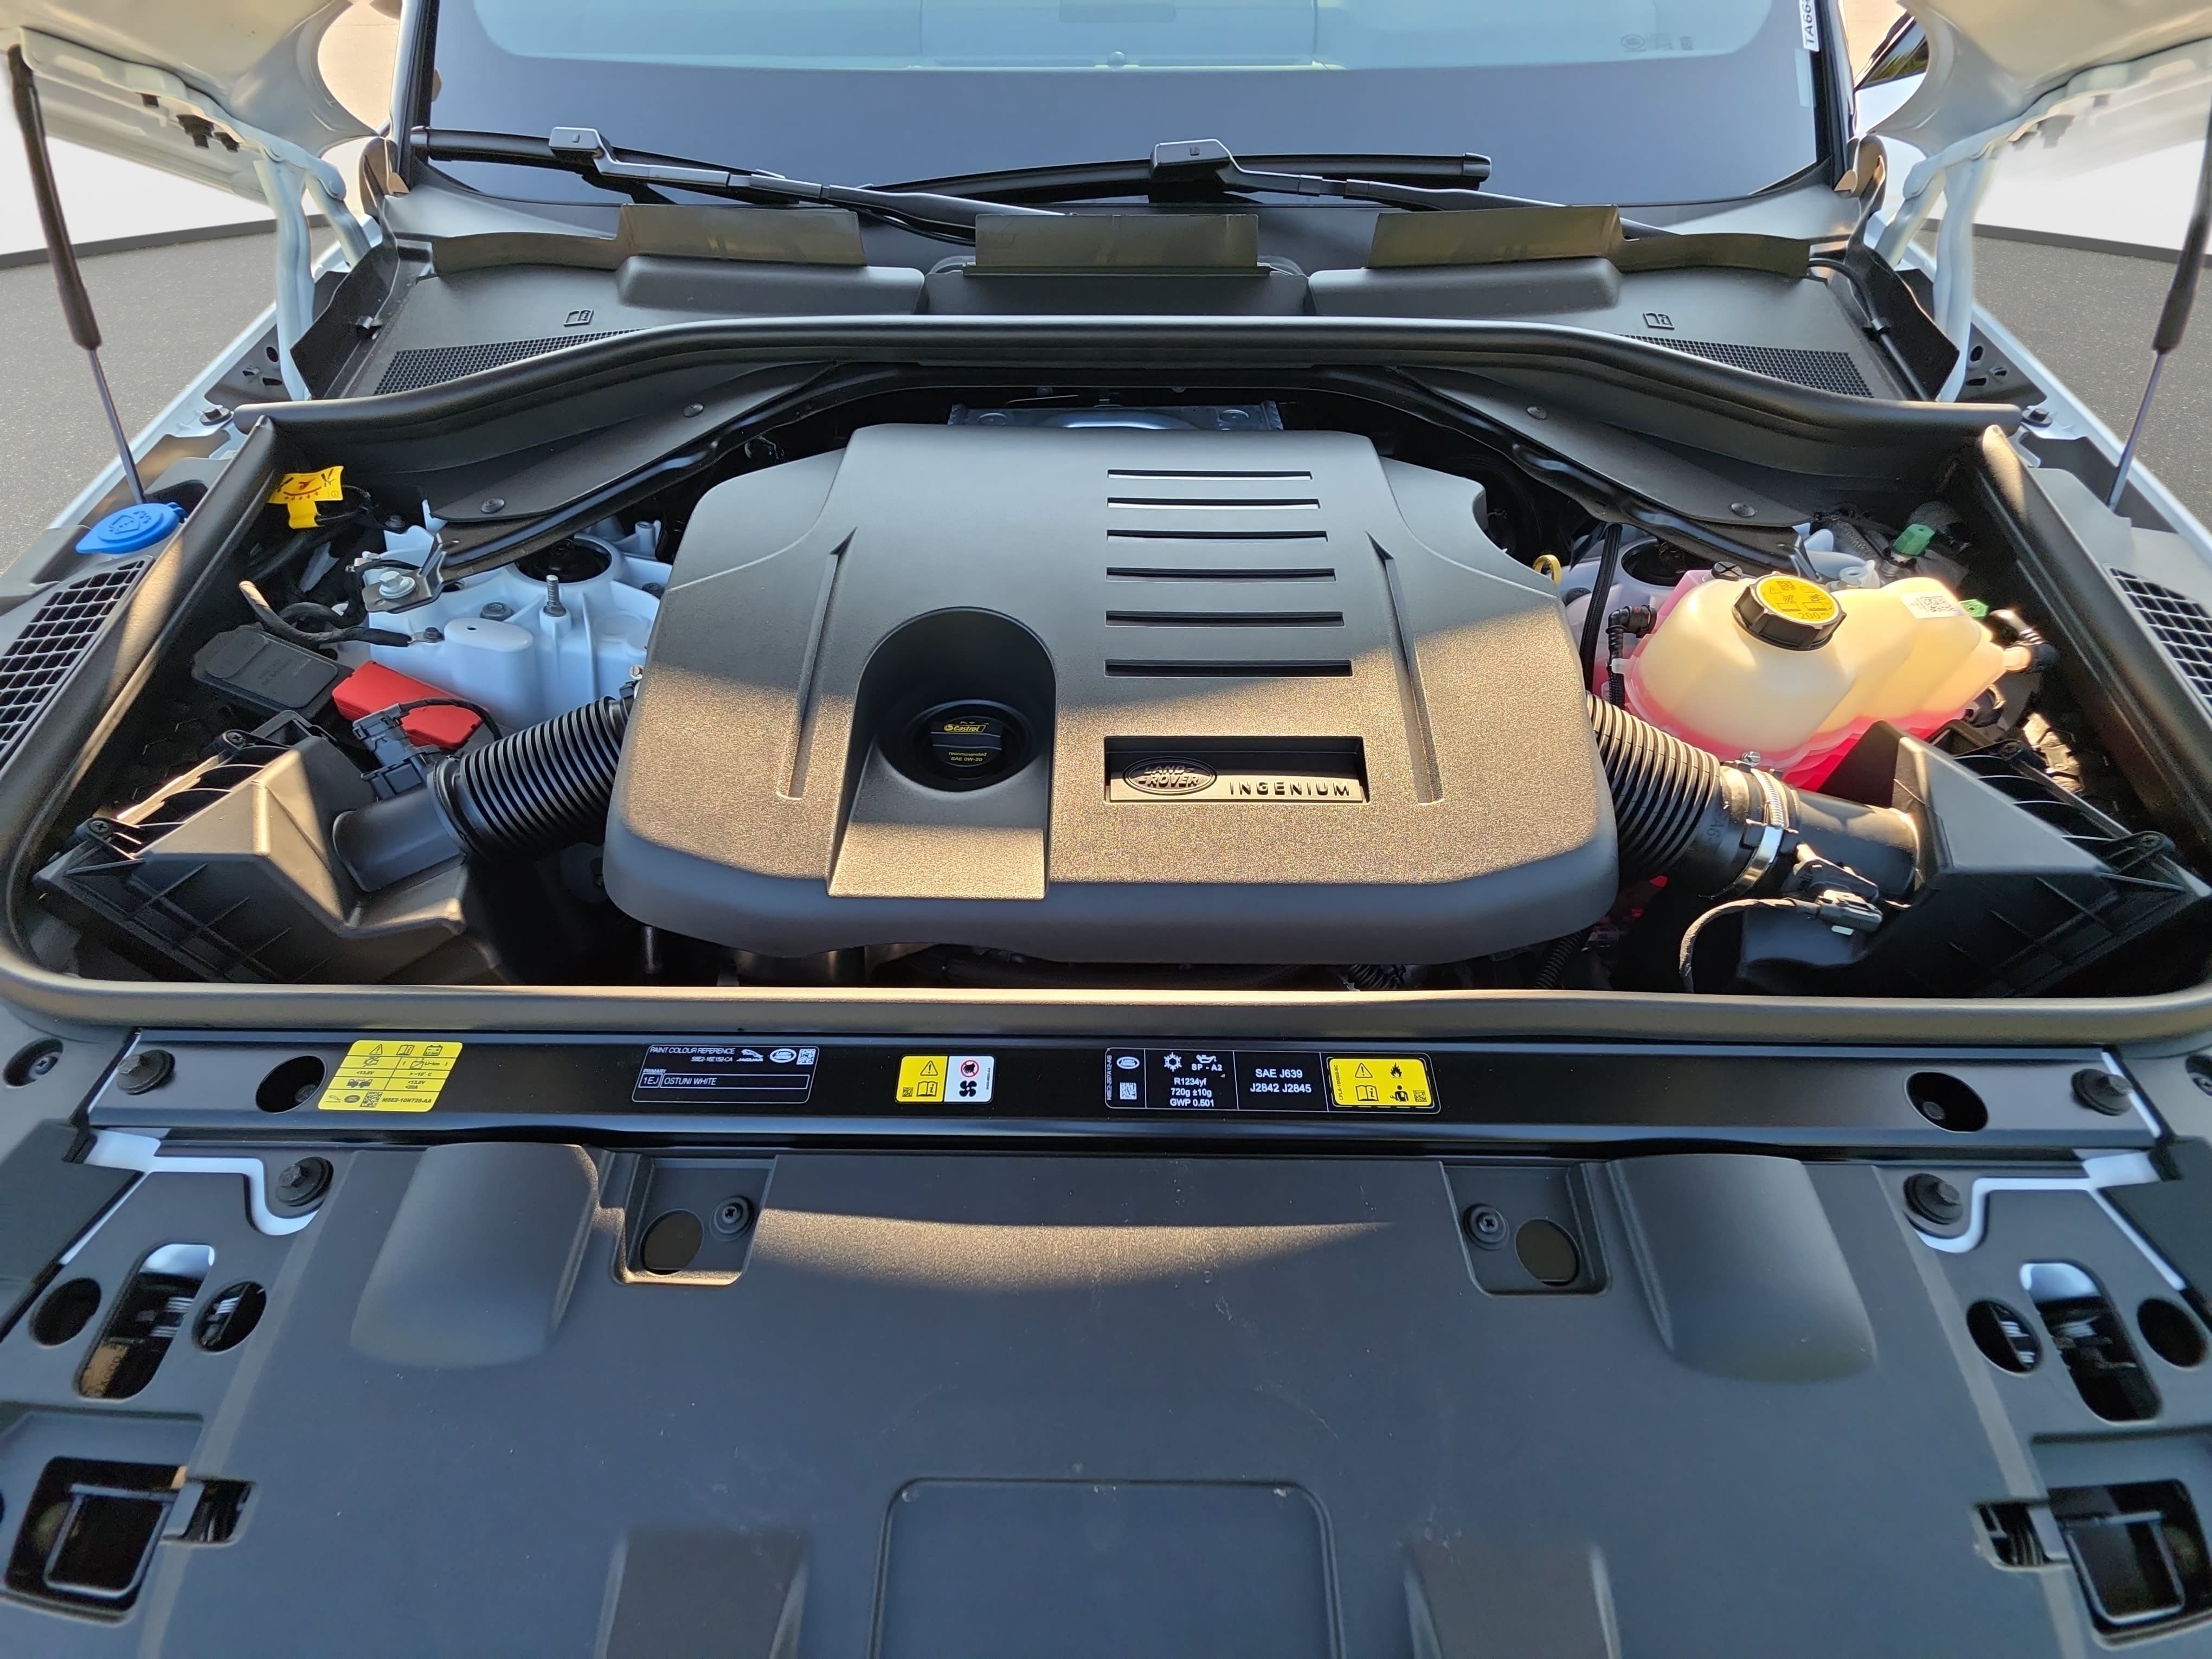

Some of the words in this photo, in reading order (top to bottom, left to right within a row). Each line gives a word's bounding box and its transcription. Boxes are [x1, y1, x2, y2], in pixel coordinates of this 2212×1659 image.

[1144, 765, 1186, 775] LAND
[1146, 775, 1199, 788] ROVER
[1230, 780, 1350, 796] INGENIUM
[1255, 1068, 1277, 1078] SAE
[1279, 1069, 1303, 1078] J639
[643, 1076, 660, 1085] 1EJ
[664, 1077, 692, 1085] OSTUNI
[692, 1077, 718, 1085] WHITE
[1174, 1077, 1207, 1087] R1234yf
[1171, 1088, 1190, 1097] 720g
[1192, 1088, 1212, 1097] ±10g
[1250, 1083, 1280, 1092] J2842
[1282, 1083, 1312, 1093] J2845
[1169, 1098, 1191, 1107] GWP
[1192, 1099, 1214, 1107] 0.501
